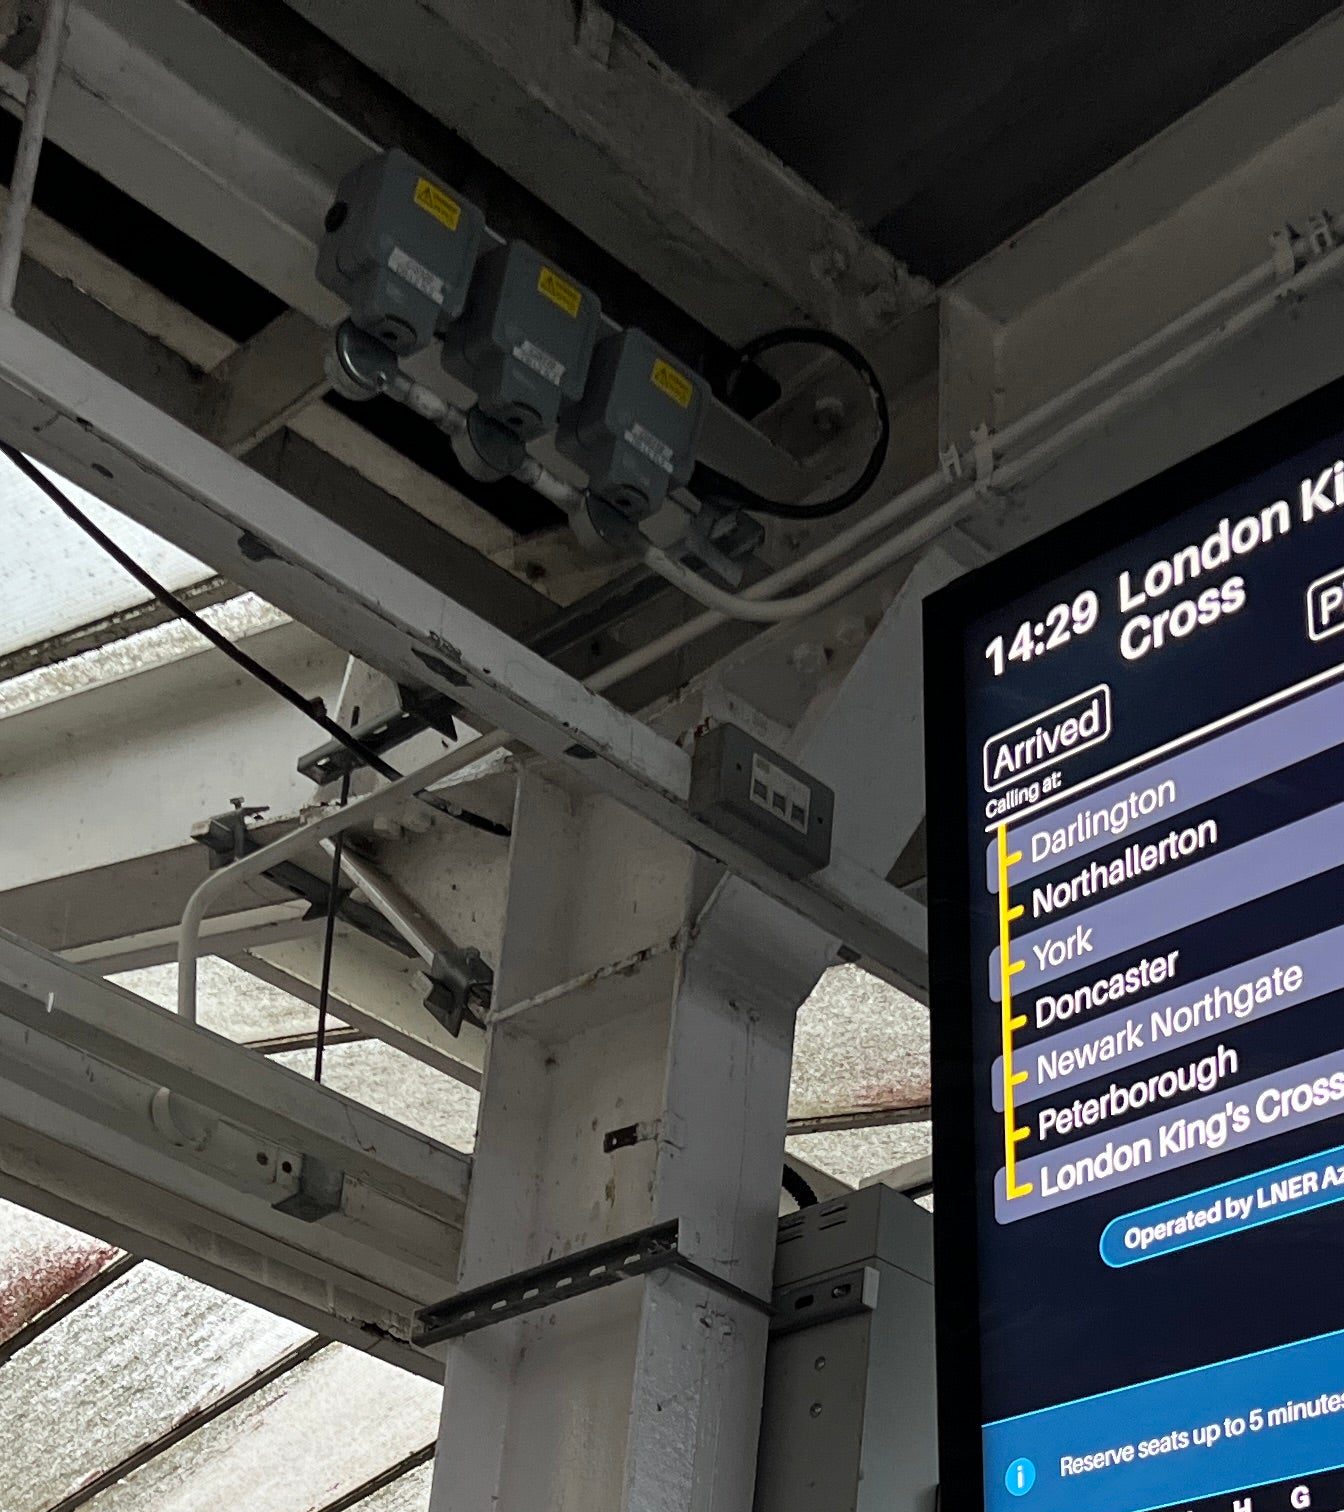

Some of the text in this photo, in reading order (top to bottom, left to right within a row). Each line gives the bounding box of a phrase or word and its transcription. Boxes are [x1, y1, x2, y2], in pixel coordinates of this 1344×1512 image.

[985, 591, 1098, 676] 14:29
[1118, 500, 1290, 612] London
[1119, 575, 1246, 661] Cross
[993, 700, 1099, 779] Arrived
[985, 770, 1063, 819] Calling at:
[1031, 778, 1176, 863] Darlington
[1032, 816, 1218, 918] Northallerton
[1034, 925, 1093, 971] York
[1036, 947, 1179, 1029] Doncaster
[1037, 1017, 1144, 1085] Newark
[1150, 963, 1304, 1039] Northgate
[1039, 1044, 1239, 1141] Peterborough
[1041, 1134, 1151, 1197] London
[1158, 1100, 1250, 1157] King's
[1124, 1199, 1221, 1250] Operated
[1225, 1193, 1252, 1223] by
[1258, 1171, 1318, 1210] LNER
[1059, 1439, 1134, 1477] Reserve
[1138, 1429, 1190, 1460] seats
[1192, 1423, 1220, 1450] up
[1224, 1416, 1245, 1437] to
[1249, 1408, 1263, 1431] 5
[1291, 1485, 1311, 1509] G
